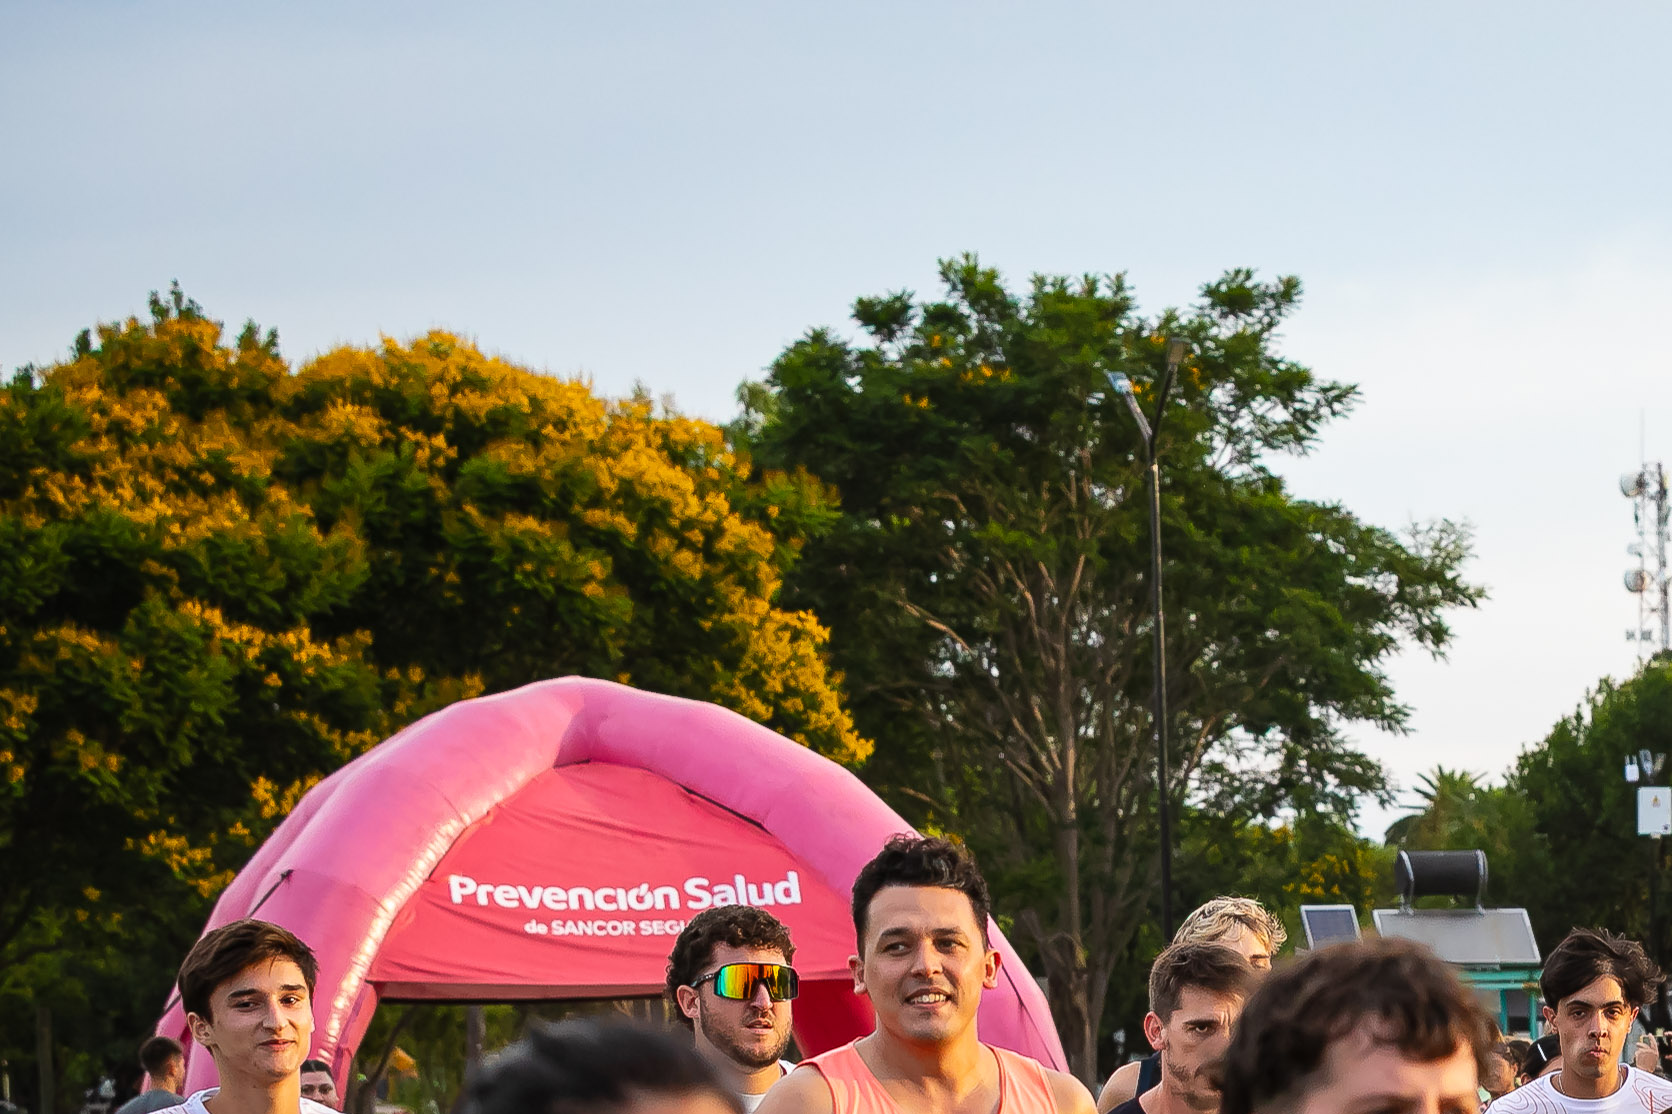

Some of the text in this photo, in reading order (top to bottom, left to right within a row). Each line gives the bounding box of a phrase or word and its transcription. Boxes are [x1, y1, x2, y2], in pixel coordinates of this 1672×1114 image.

[449, 870, 802, 911] Prevención Salud
[523, 918, 549, 936] de
[551, 918, 636, 936] SANCOR
